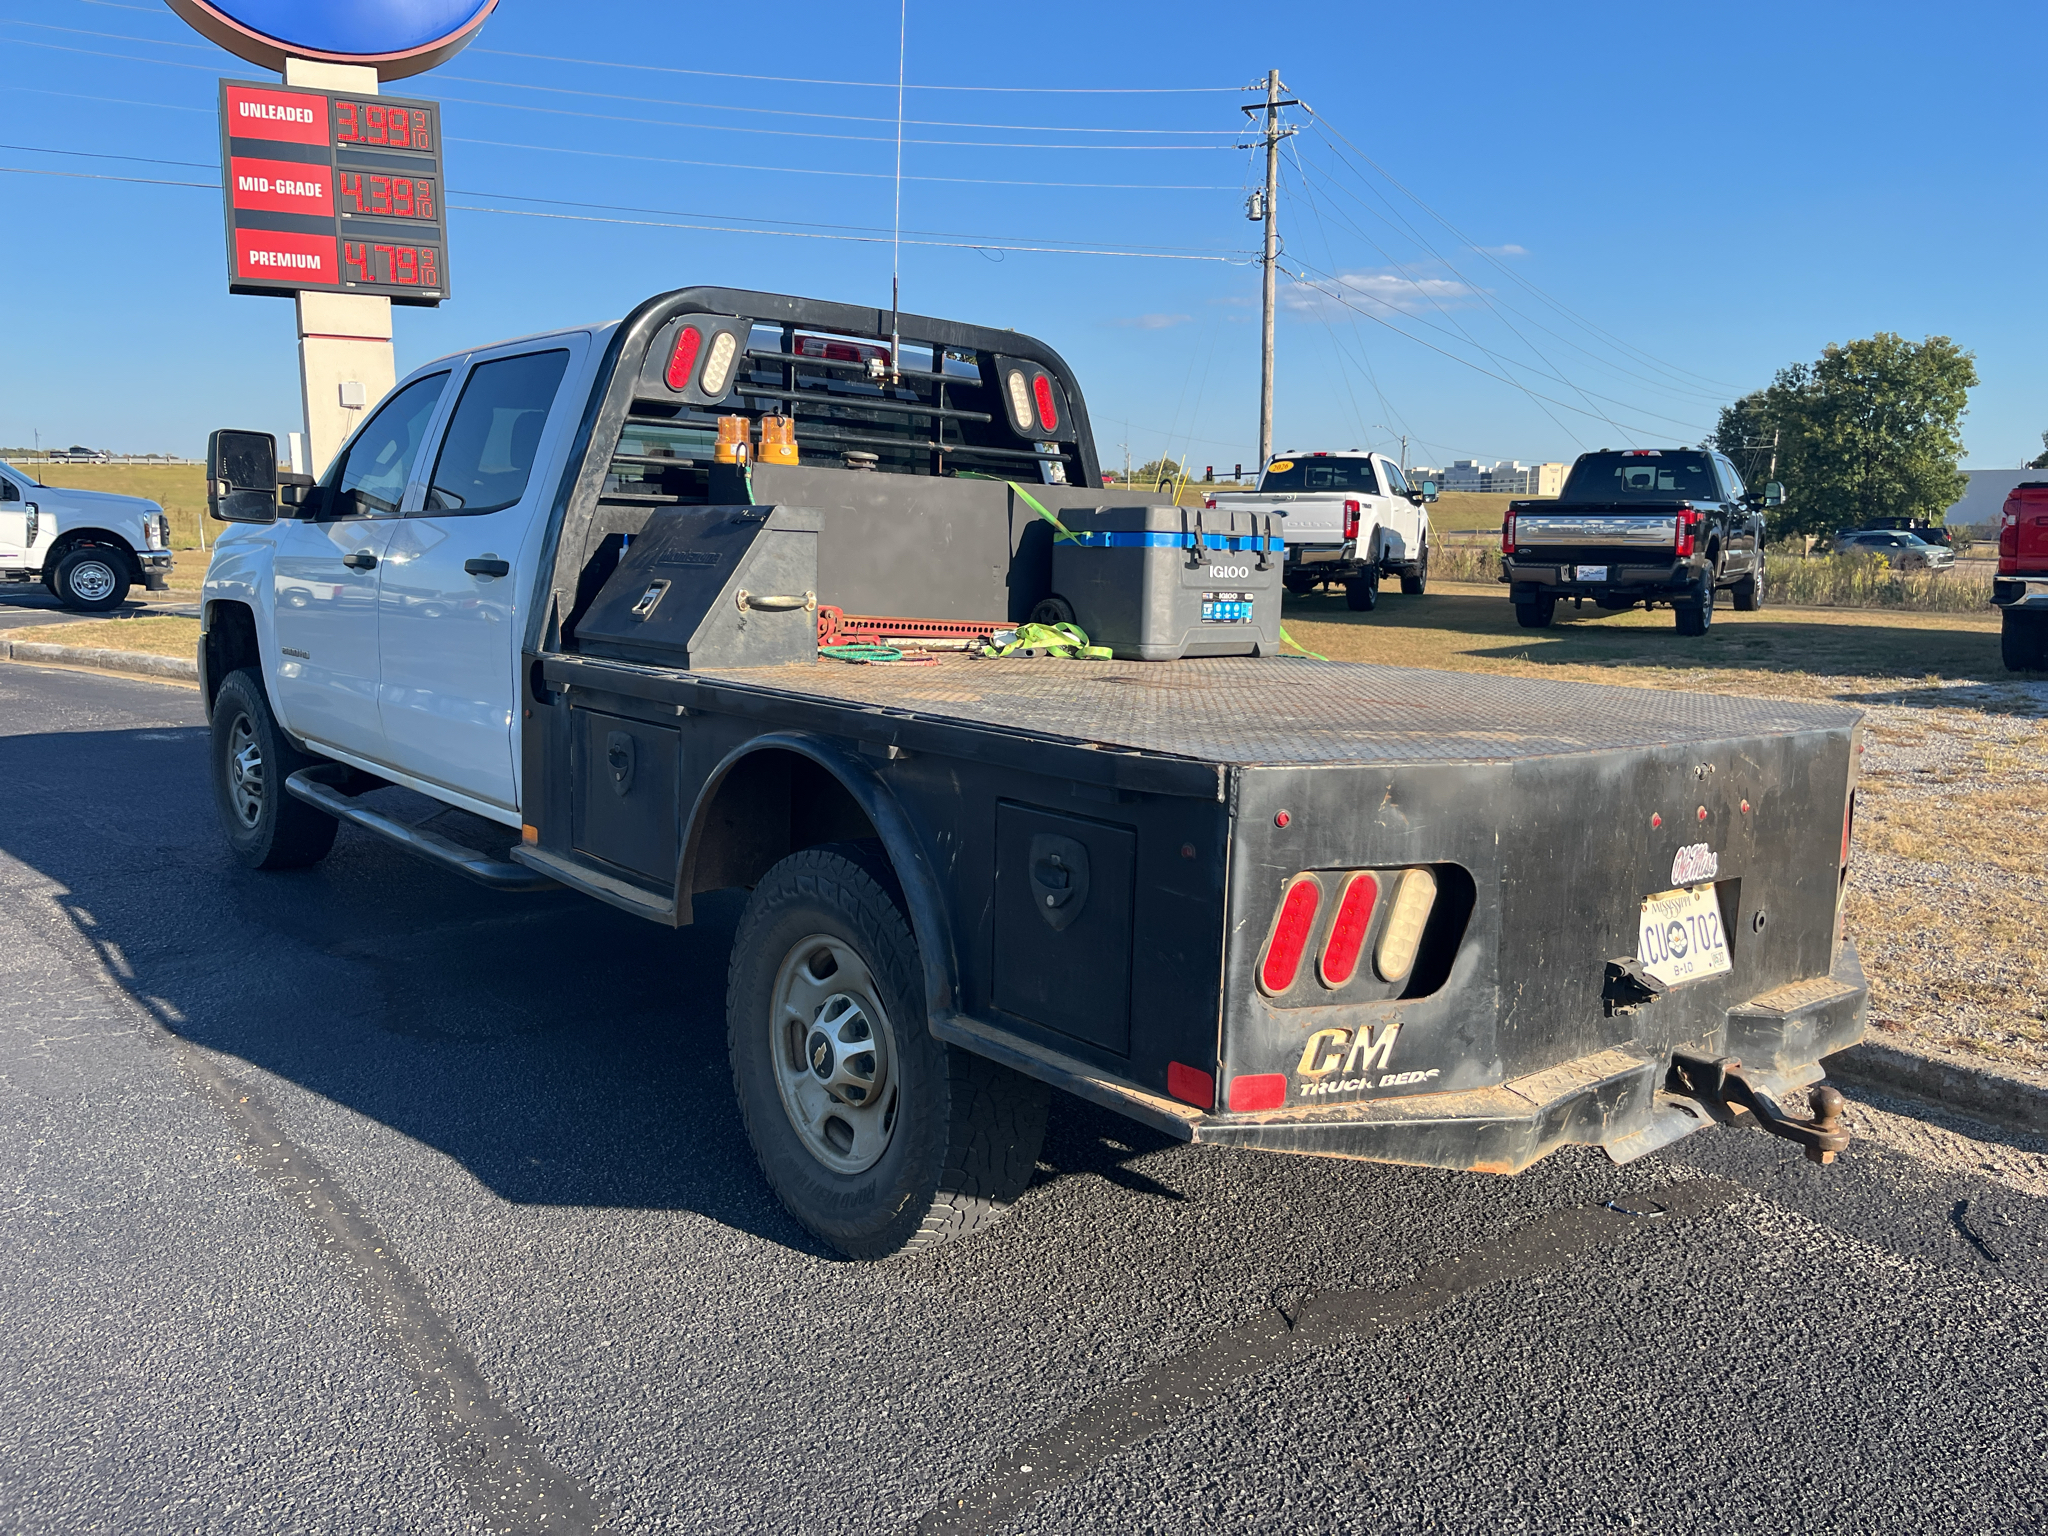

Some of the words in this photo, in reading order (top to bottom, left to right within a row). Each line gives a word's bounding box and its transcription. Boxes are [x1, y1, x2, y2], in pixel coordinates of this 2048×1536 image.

[239, 102, 314, 124] UNLEADED
[335, 102, 411, 147] 3.99
[238, 176, 323, 198] MID-GRADE
[340, 173, 415, 217] 4.39
[249, 250, 321, 270] PREMIUM
[345, 243, 418, 285] 4.79
[1272, 463, 1289, 471] 2026
[1209, 566, 1249, 579] IGLOO
[1218, 592, 1238, 600] IGLOO
[1686, 911, 1723, 954] 702
[1673, 961, 1693, 976] 8-10
[1297, 1023, 1404, 1077] CM
[1300, 1078, 1374, 1096] TRUCK
[1379, 1068, 1440, 1088] BEDS
